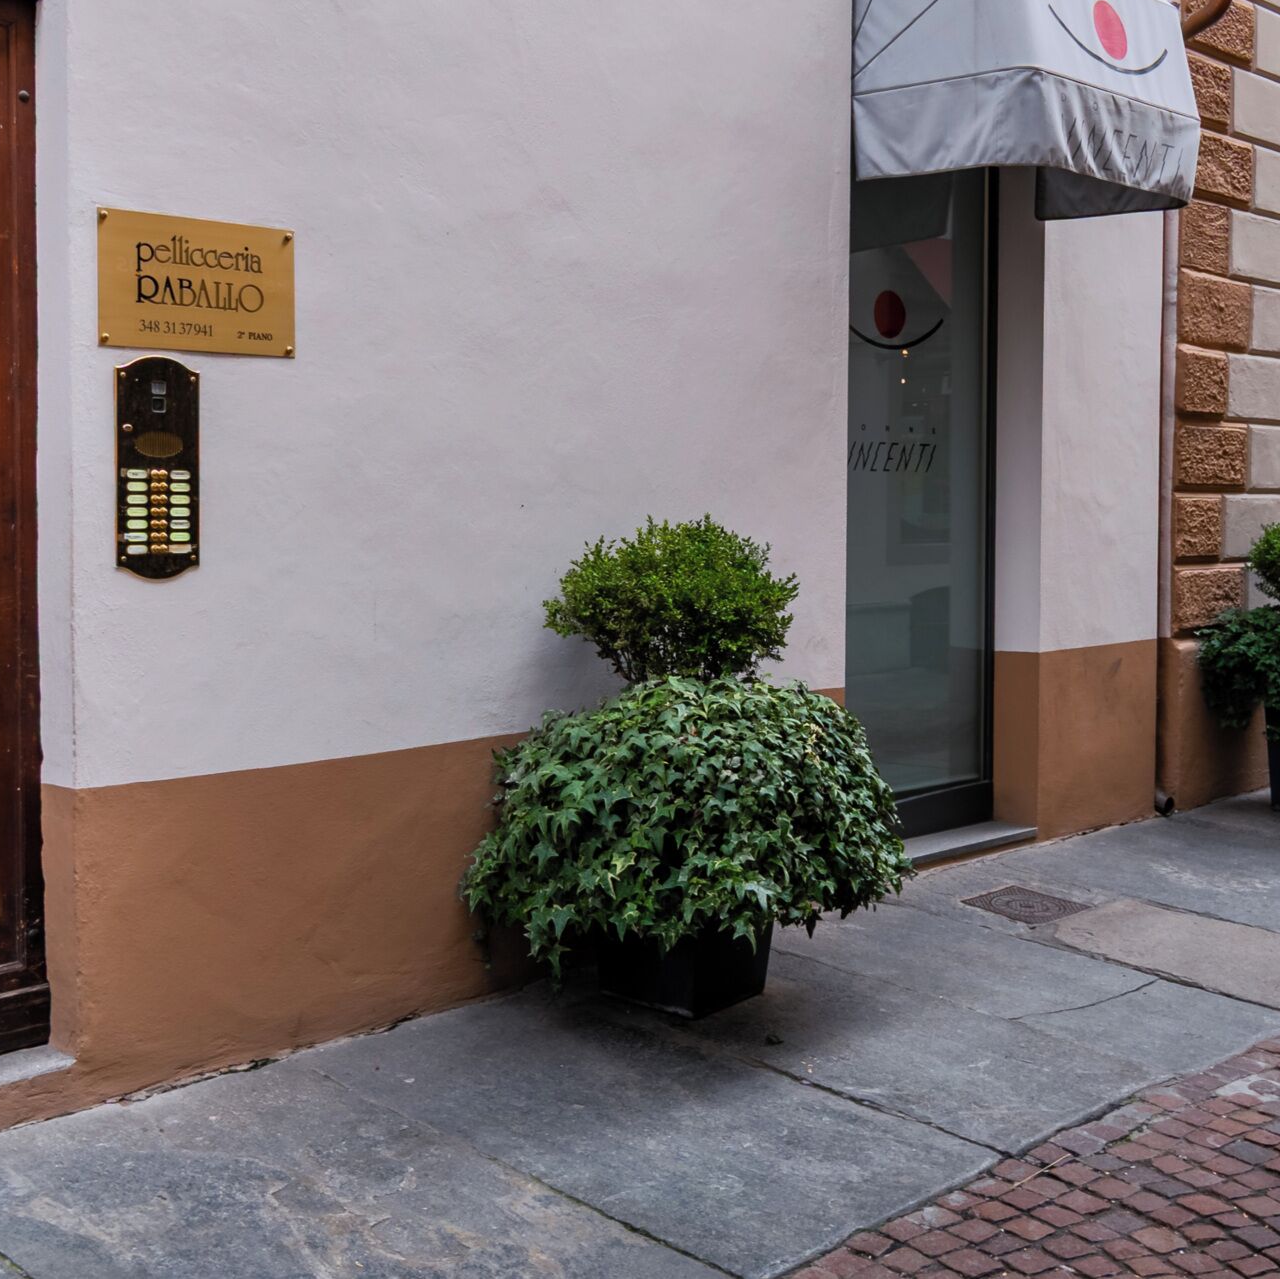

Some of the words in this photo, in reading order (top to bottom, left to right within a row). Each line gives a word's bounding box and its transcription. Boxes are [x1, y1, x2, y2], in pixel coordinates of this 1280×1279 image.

[135, 235, 263, 273] pellicceria
[135, 274, 264, 313] RABALLO
[138, 319, 160, 333] 348
[248, 332, 273, 341] PIANO
[848, 441, 937, 472] INCENTI
